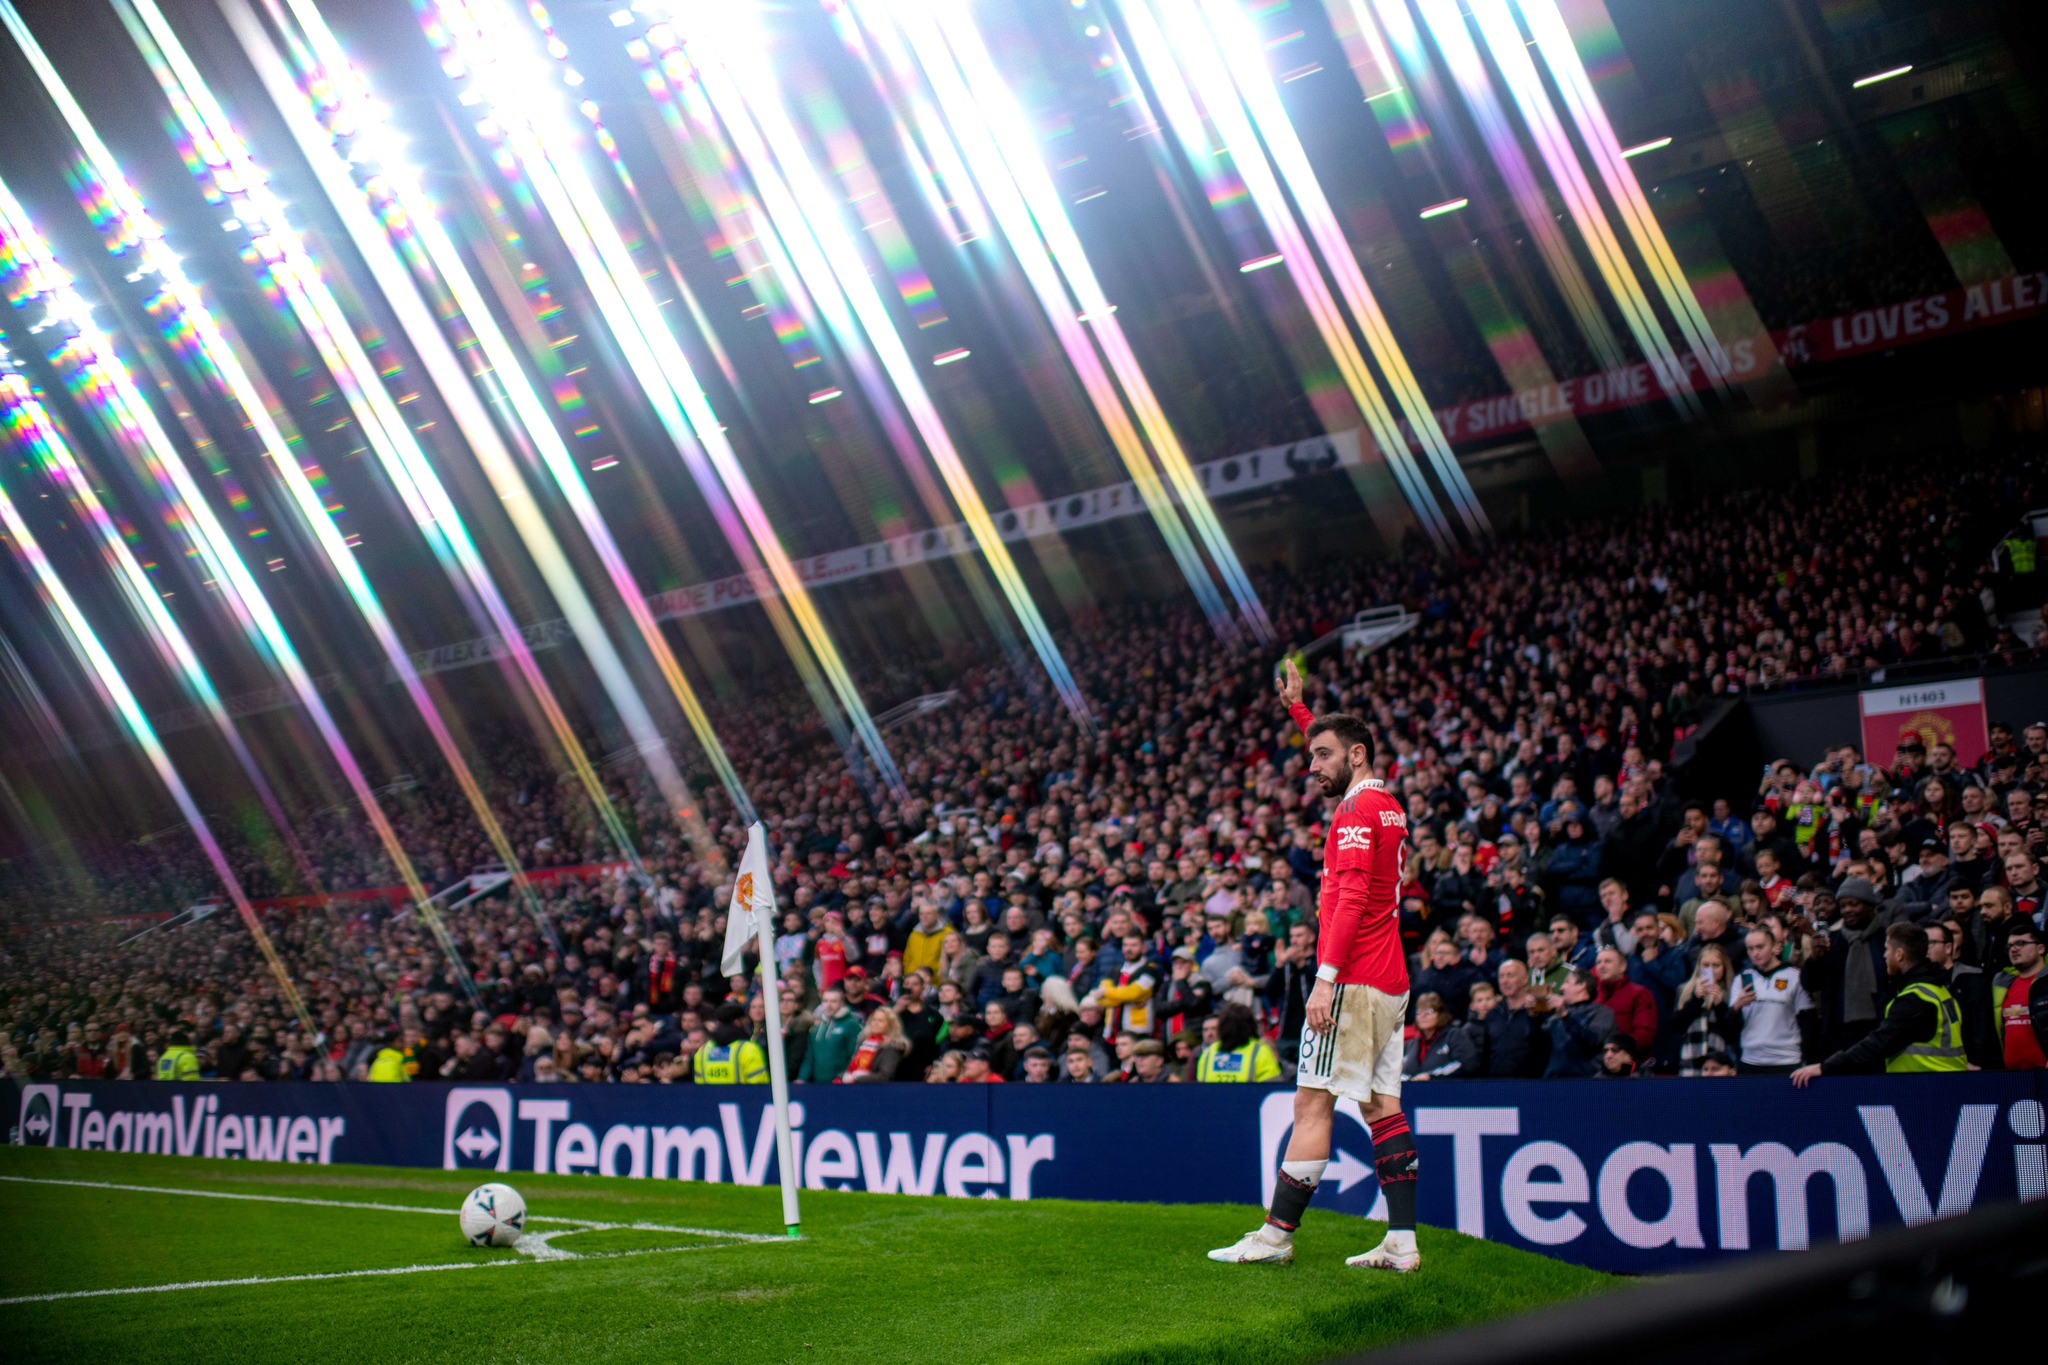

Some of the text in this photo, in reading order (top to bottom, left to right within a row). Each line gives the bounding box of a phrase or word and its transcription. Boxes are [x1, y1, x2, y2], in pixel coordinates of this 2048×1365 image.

[1466, 381, 1575, 433] SINGLE
[1583, 364, 1648, 406] ONE
[1703, 339, 1757, 378] US
[1832, 295, 1950, 350] LOVES
[1899, 689, 1946, 706] N1403
[1337, 826, 1371, 845] DXC
[1302, 1028, 1317, 1059] 8
[63, 1093, 345, 1164] TeamViewer
[518, 1099, 1054, 1200] TeamViewer
[1414, 1099, 2048, 1251] TeamVi
